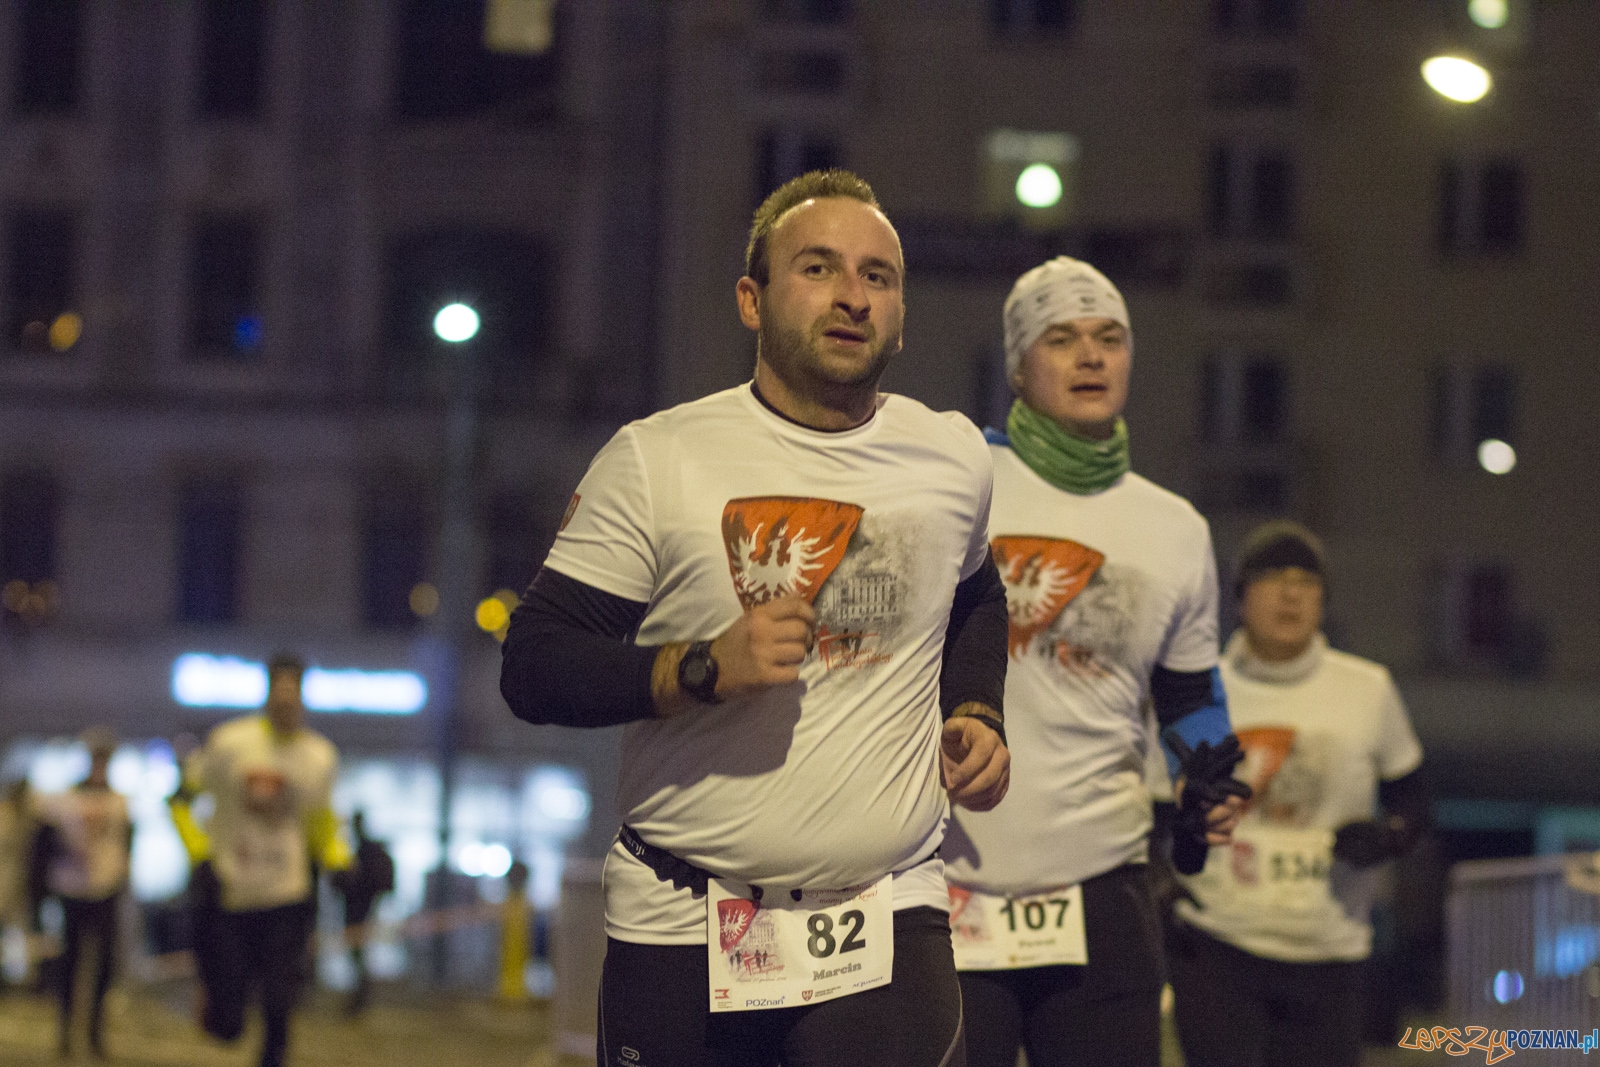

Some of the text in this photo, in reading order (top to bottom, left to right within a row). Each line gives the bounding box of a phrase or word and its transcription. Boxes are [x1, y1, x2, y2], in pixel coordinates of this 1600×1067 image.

[1000, 898, 1069, 932] 107
[807, 909, 866, 959] 82
[813, 962, 862, 981] Marcin
